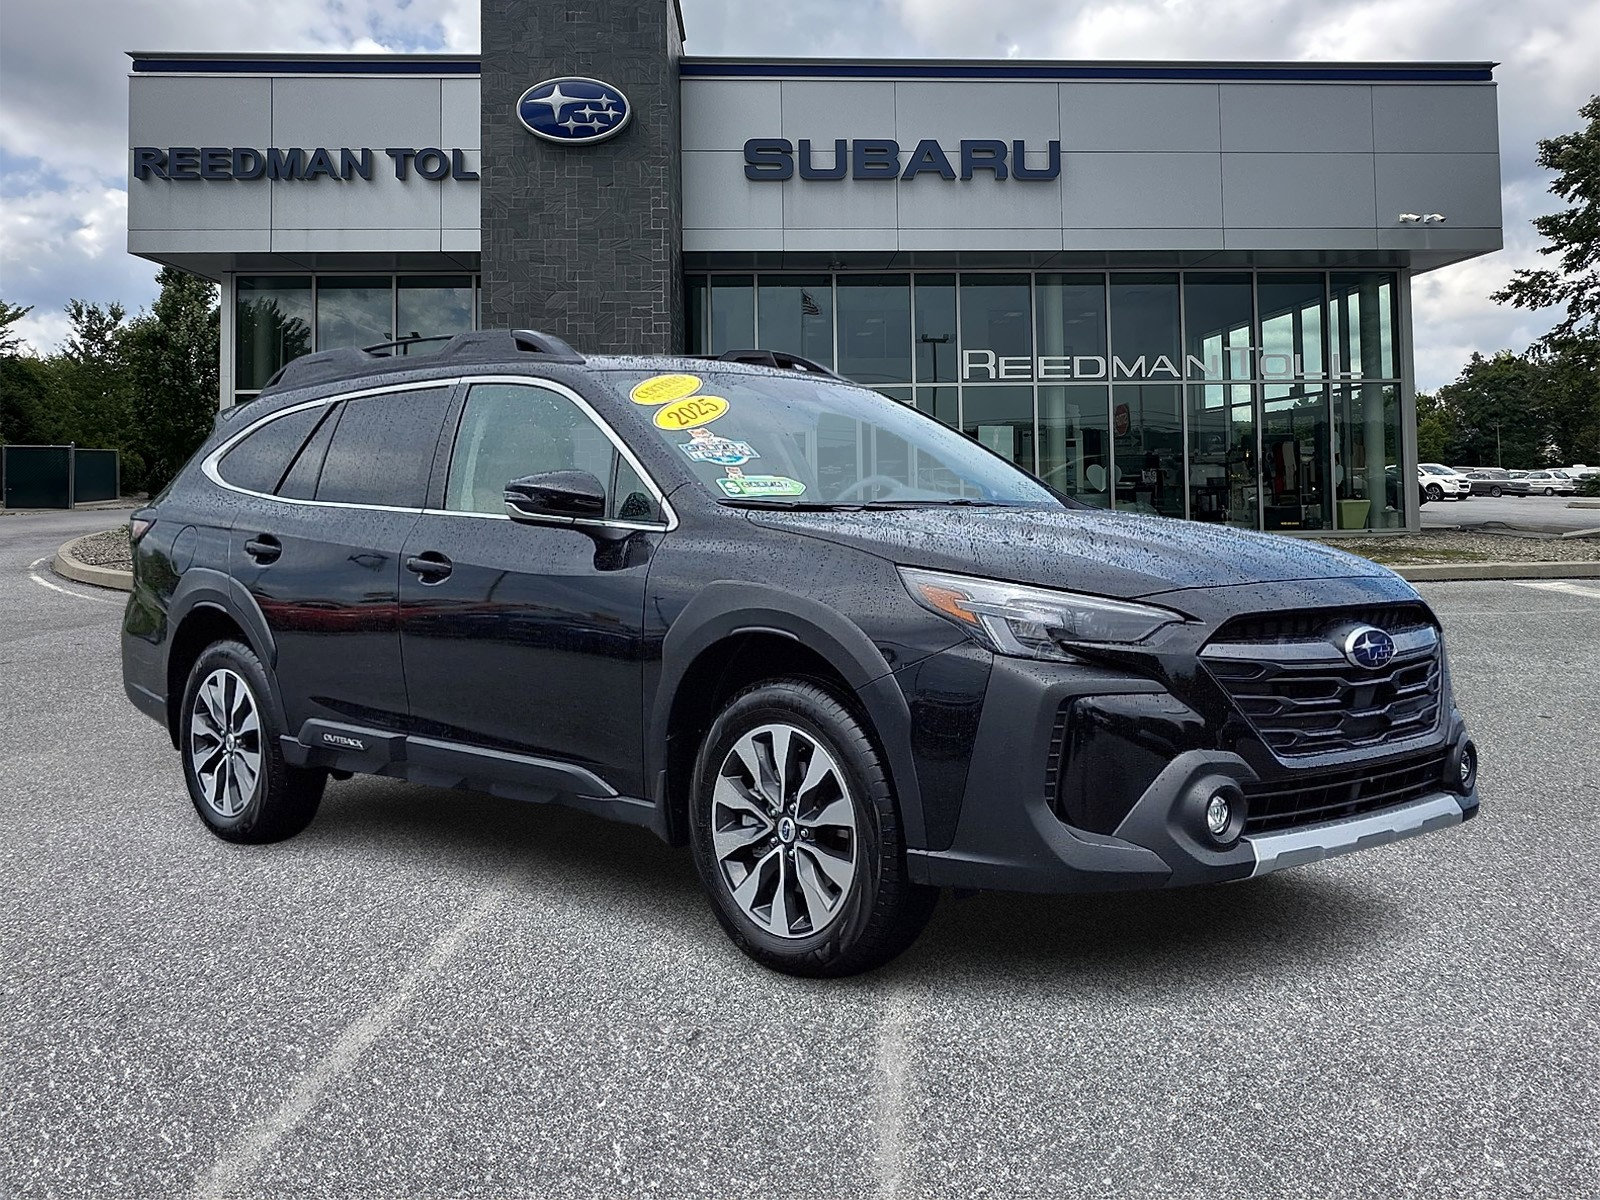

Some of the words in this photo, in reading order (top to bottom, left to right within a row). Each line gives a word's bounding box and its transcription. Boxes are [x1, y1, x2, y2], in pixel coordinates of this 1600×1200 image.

[133, 147, 373, 181] REEDMAN
[744, 138, 1061, 181] SUBARU
[666, 398, 719, 426] 2025
[323, 733, 364, 750] OUTBACK
